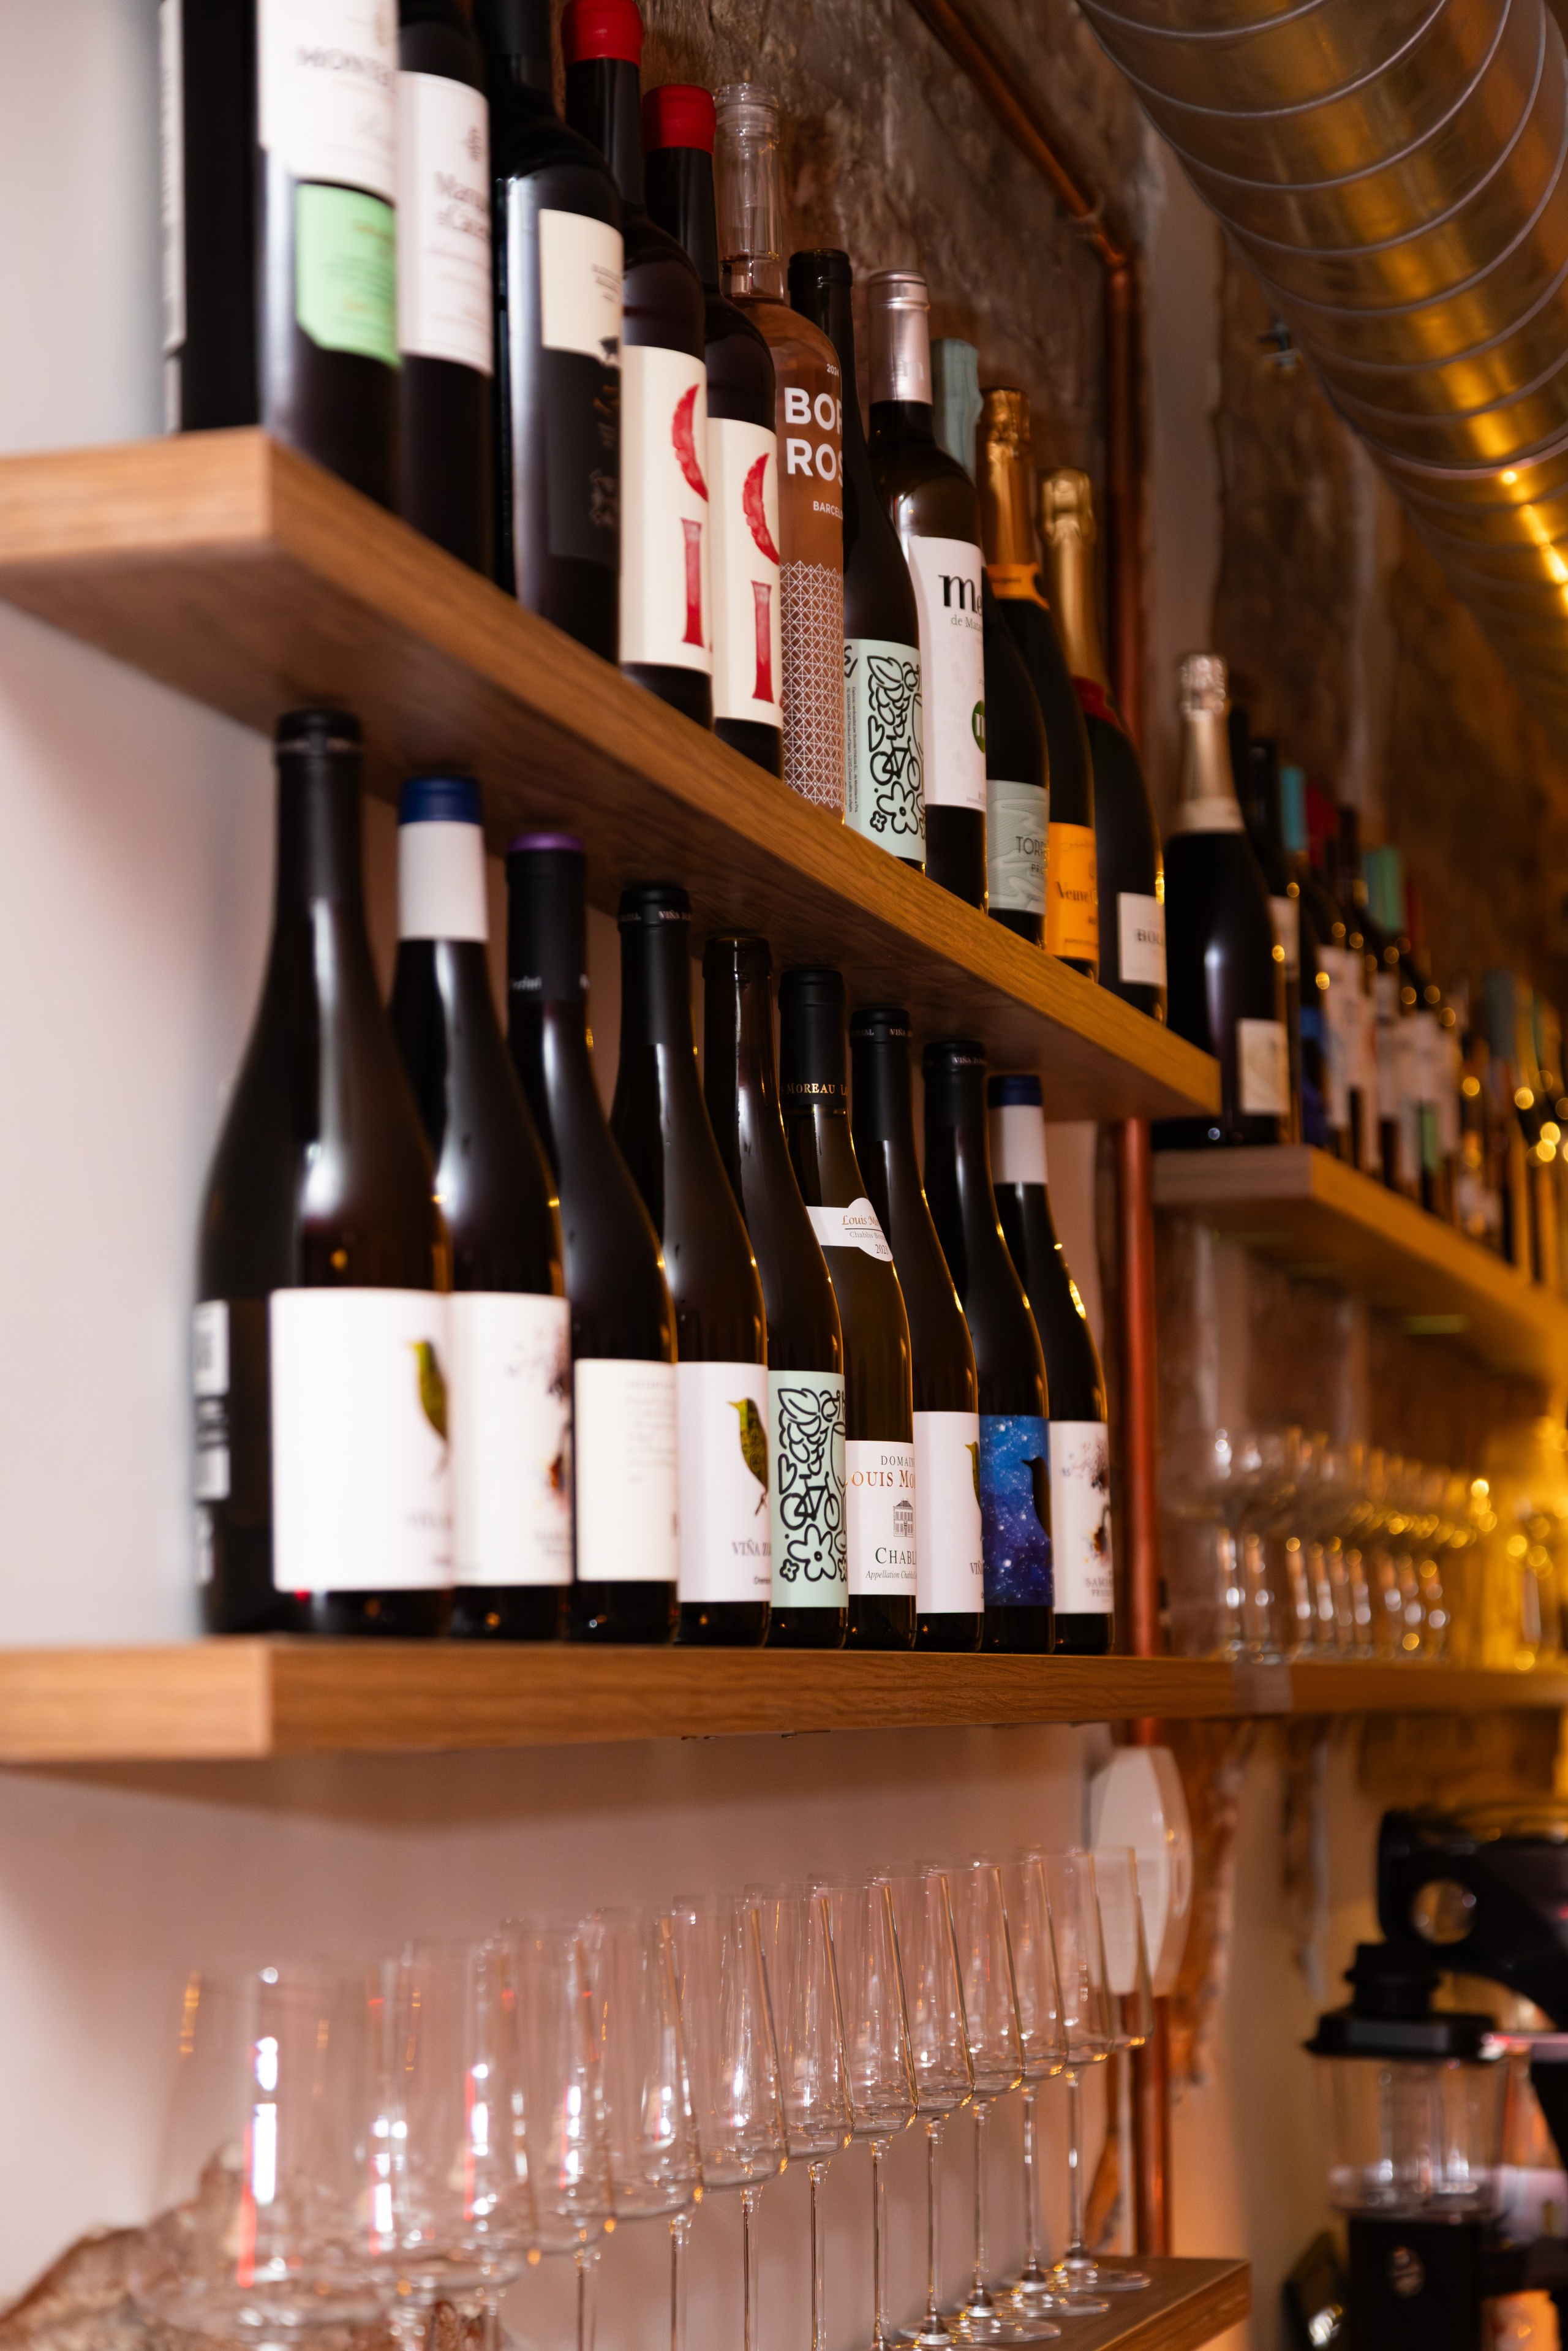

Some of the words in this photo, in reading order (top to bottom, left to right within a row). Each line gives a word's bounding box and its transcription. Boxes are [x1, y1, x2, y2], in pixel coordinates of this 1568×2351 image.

[951, 614, 963, 626] de
[786, 1082, 835, 1095] MOREAU
[842, 1215, 867, 1225] Louis
[731, 1538, 761, 1557] VIÑA
[865, 1570, 900, 1580] Appellation
